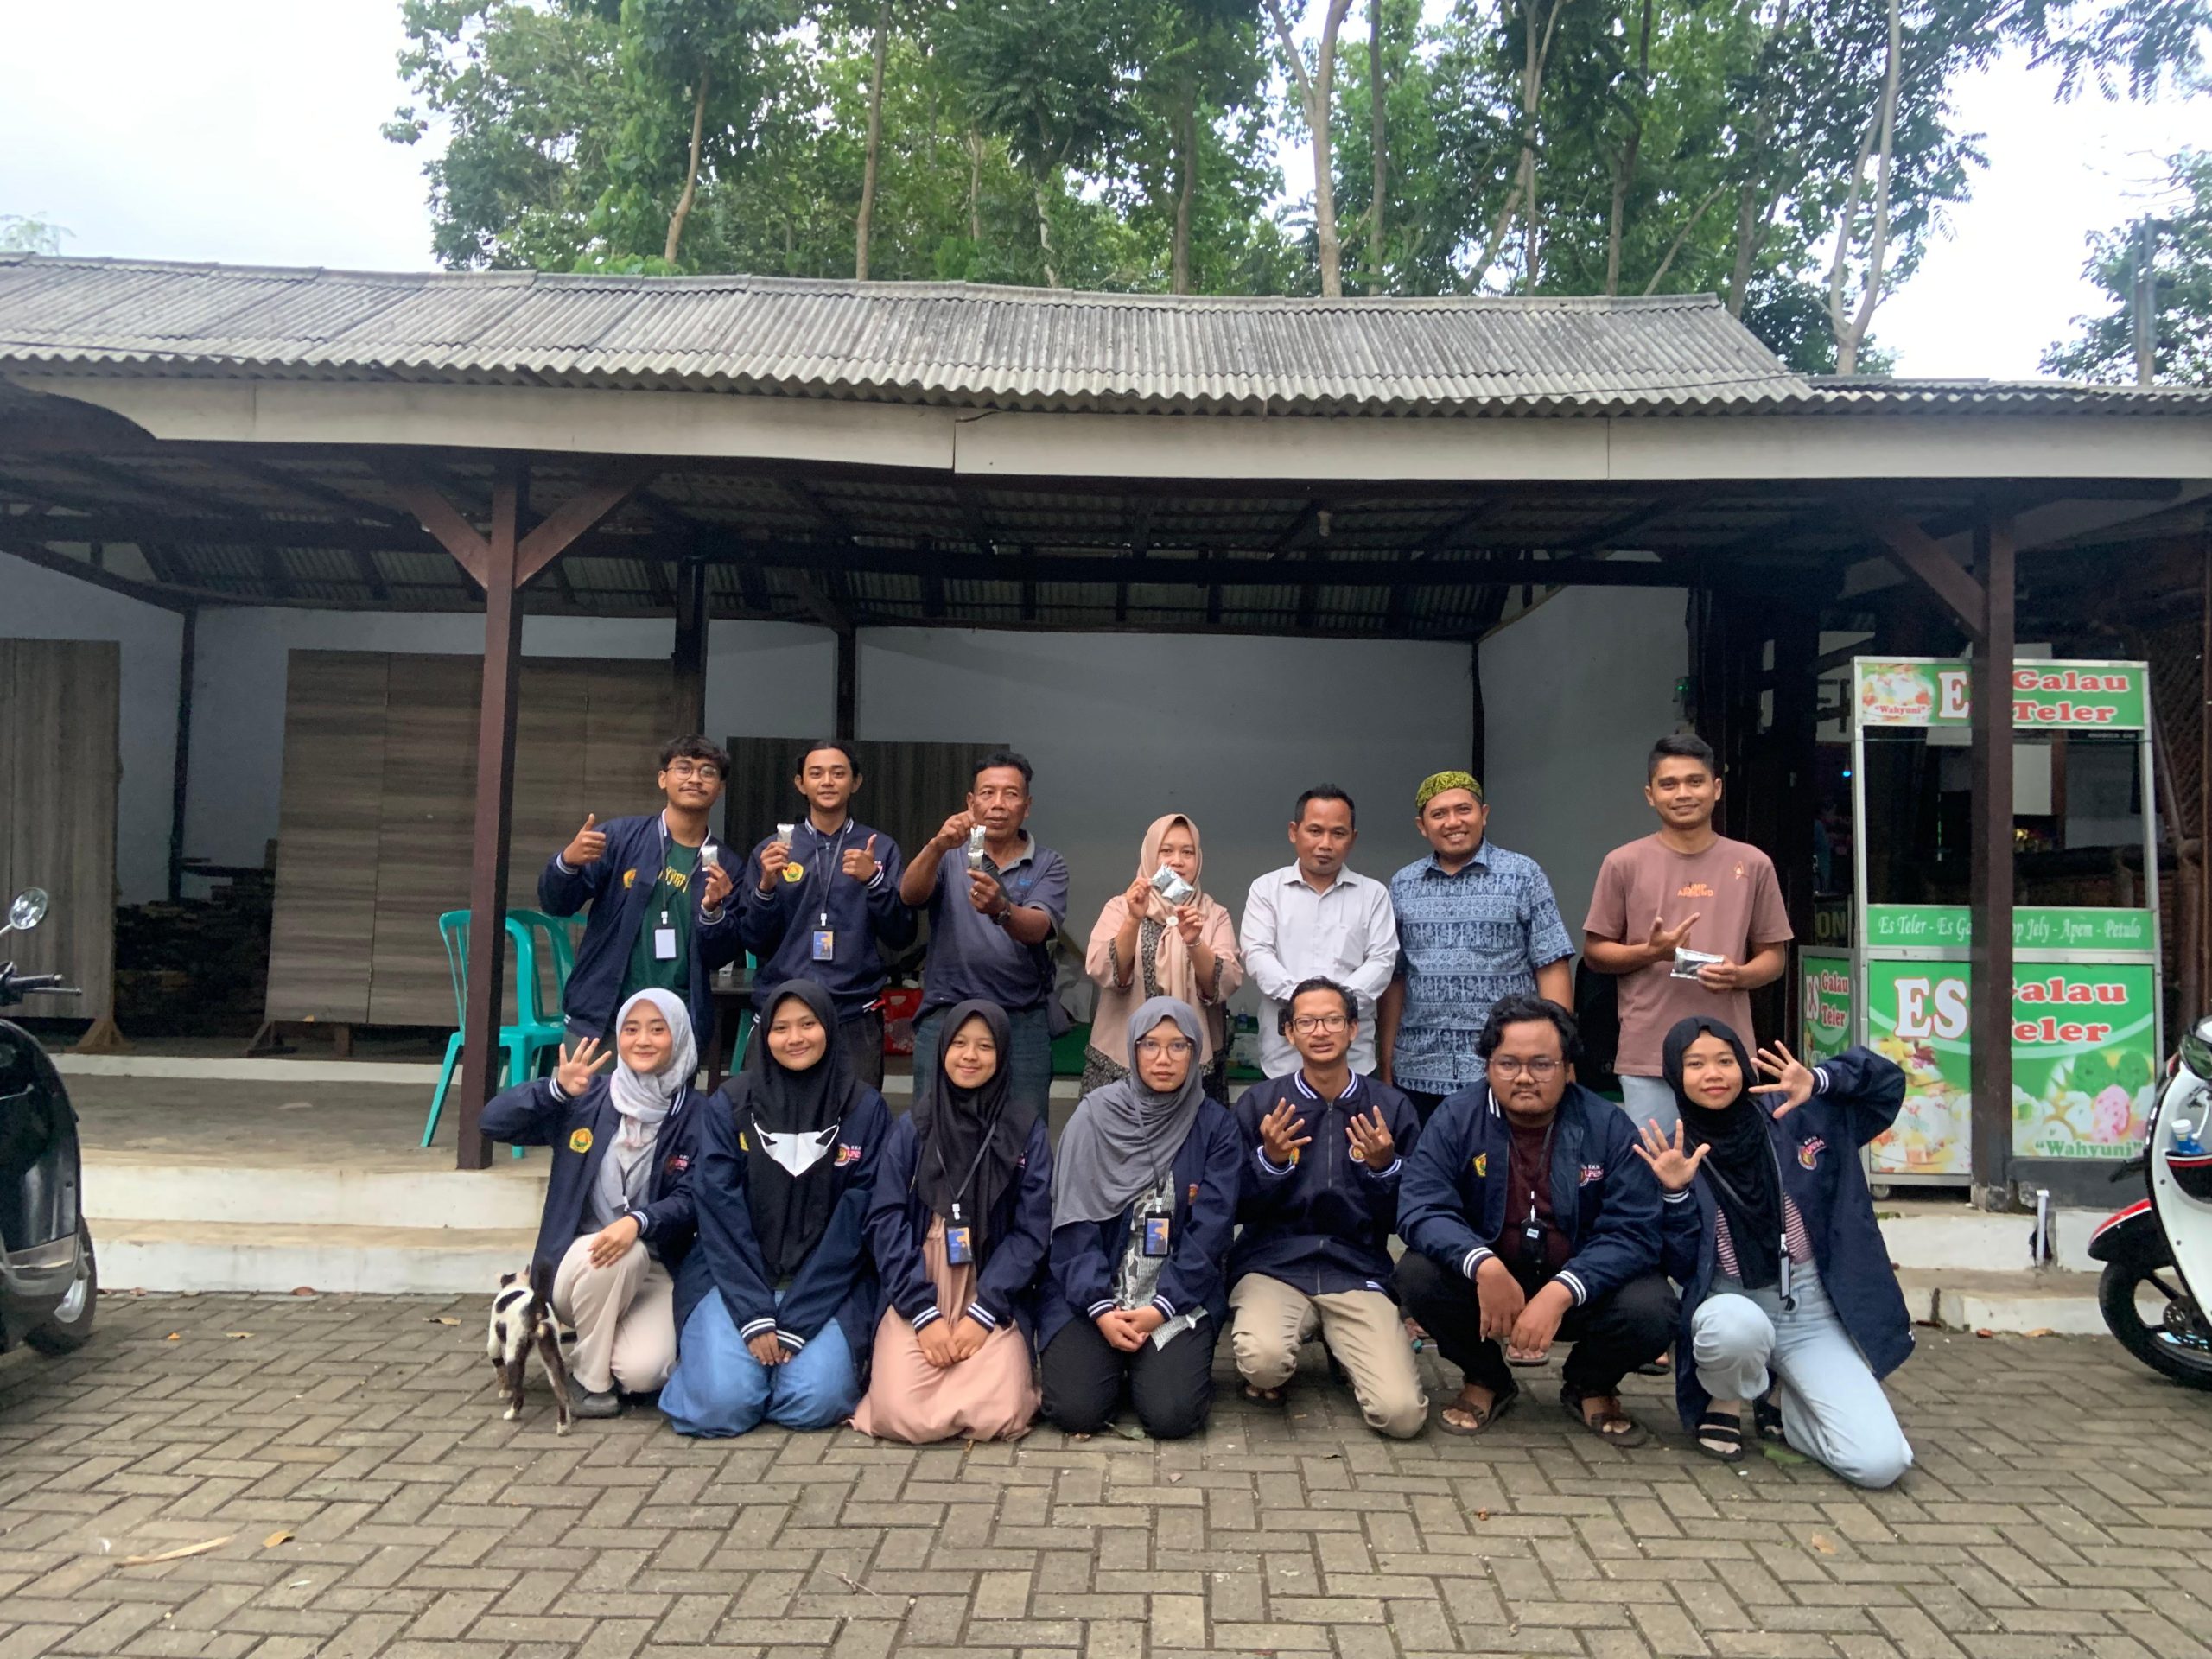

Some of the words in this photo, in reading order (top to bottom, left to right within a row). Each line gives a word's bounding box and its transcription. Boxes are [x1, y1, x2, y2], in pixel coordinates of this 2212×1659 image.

[2012, 670, 2130, 691] Galau
[1939, 671, 1971, 720] E
[2012, 701, 2117, 723] Teler
[1878, 916, 1895, 935] Es
[1897, 913, 1927, 935] Teler
[1936, 917, 1953, 936] Es
[1821, 969, 1850, 995] Galau
[2012, 976, 2128, 1005] alau
[1805, 975, 1820, 1020] ES
[1893, 977, 1969, 1039] ES
[1821, 1002, 1847, 1027] Teler
[2012, 1015, 2112, 1043] eler
